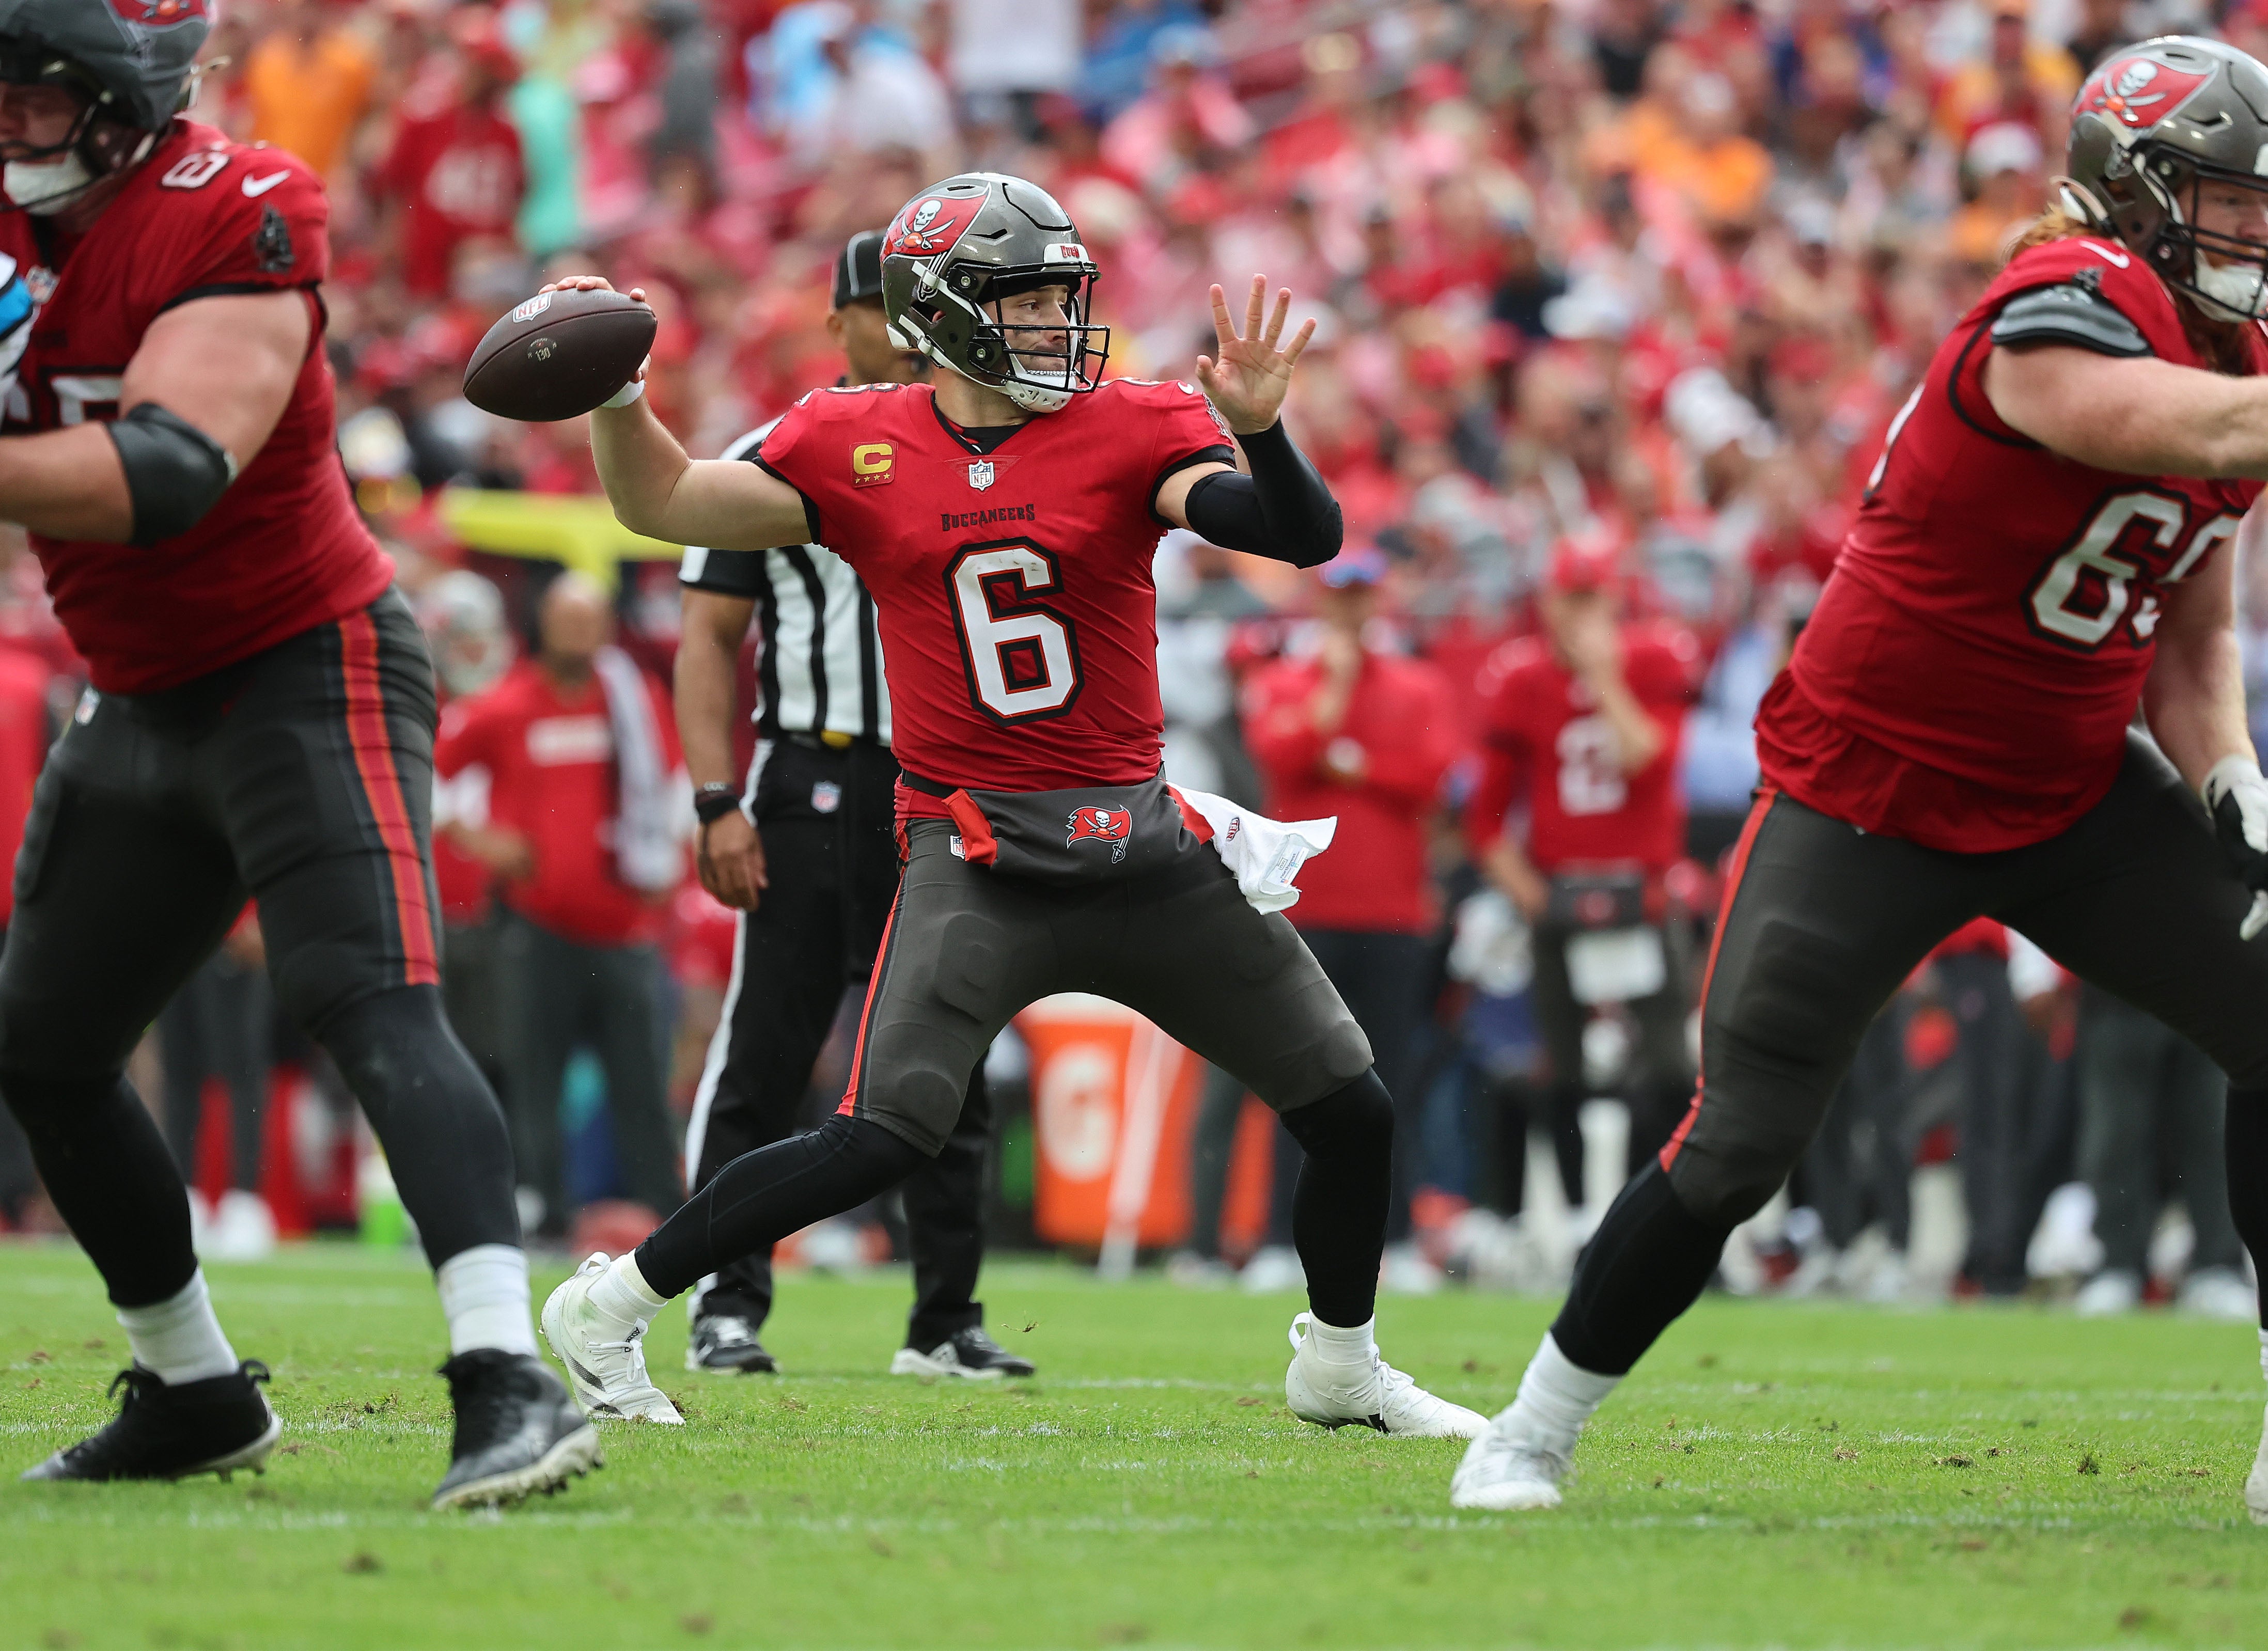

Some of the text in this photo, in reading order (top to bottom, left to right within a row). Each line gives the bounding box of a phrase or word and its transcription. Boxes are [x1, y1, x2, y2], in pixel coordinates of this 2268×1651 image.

[518, 300, 546, 318] NFL
[853, 443, 893, 475] C
[973, 474, 990, 485] NFL
[940, 503, 1036, 531] BUCCANEERS
[943, 536, 1084, 727] 6
[1226, 819, 1239, 839] NFL
[1280, 853, 1296, 878] northwest
